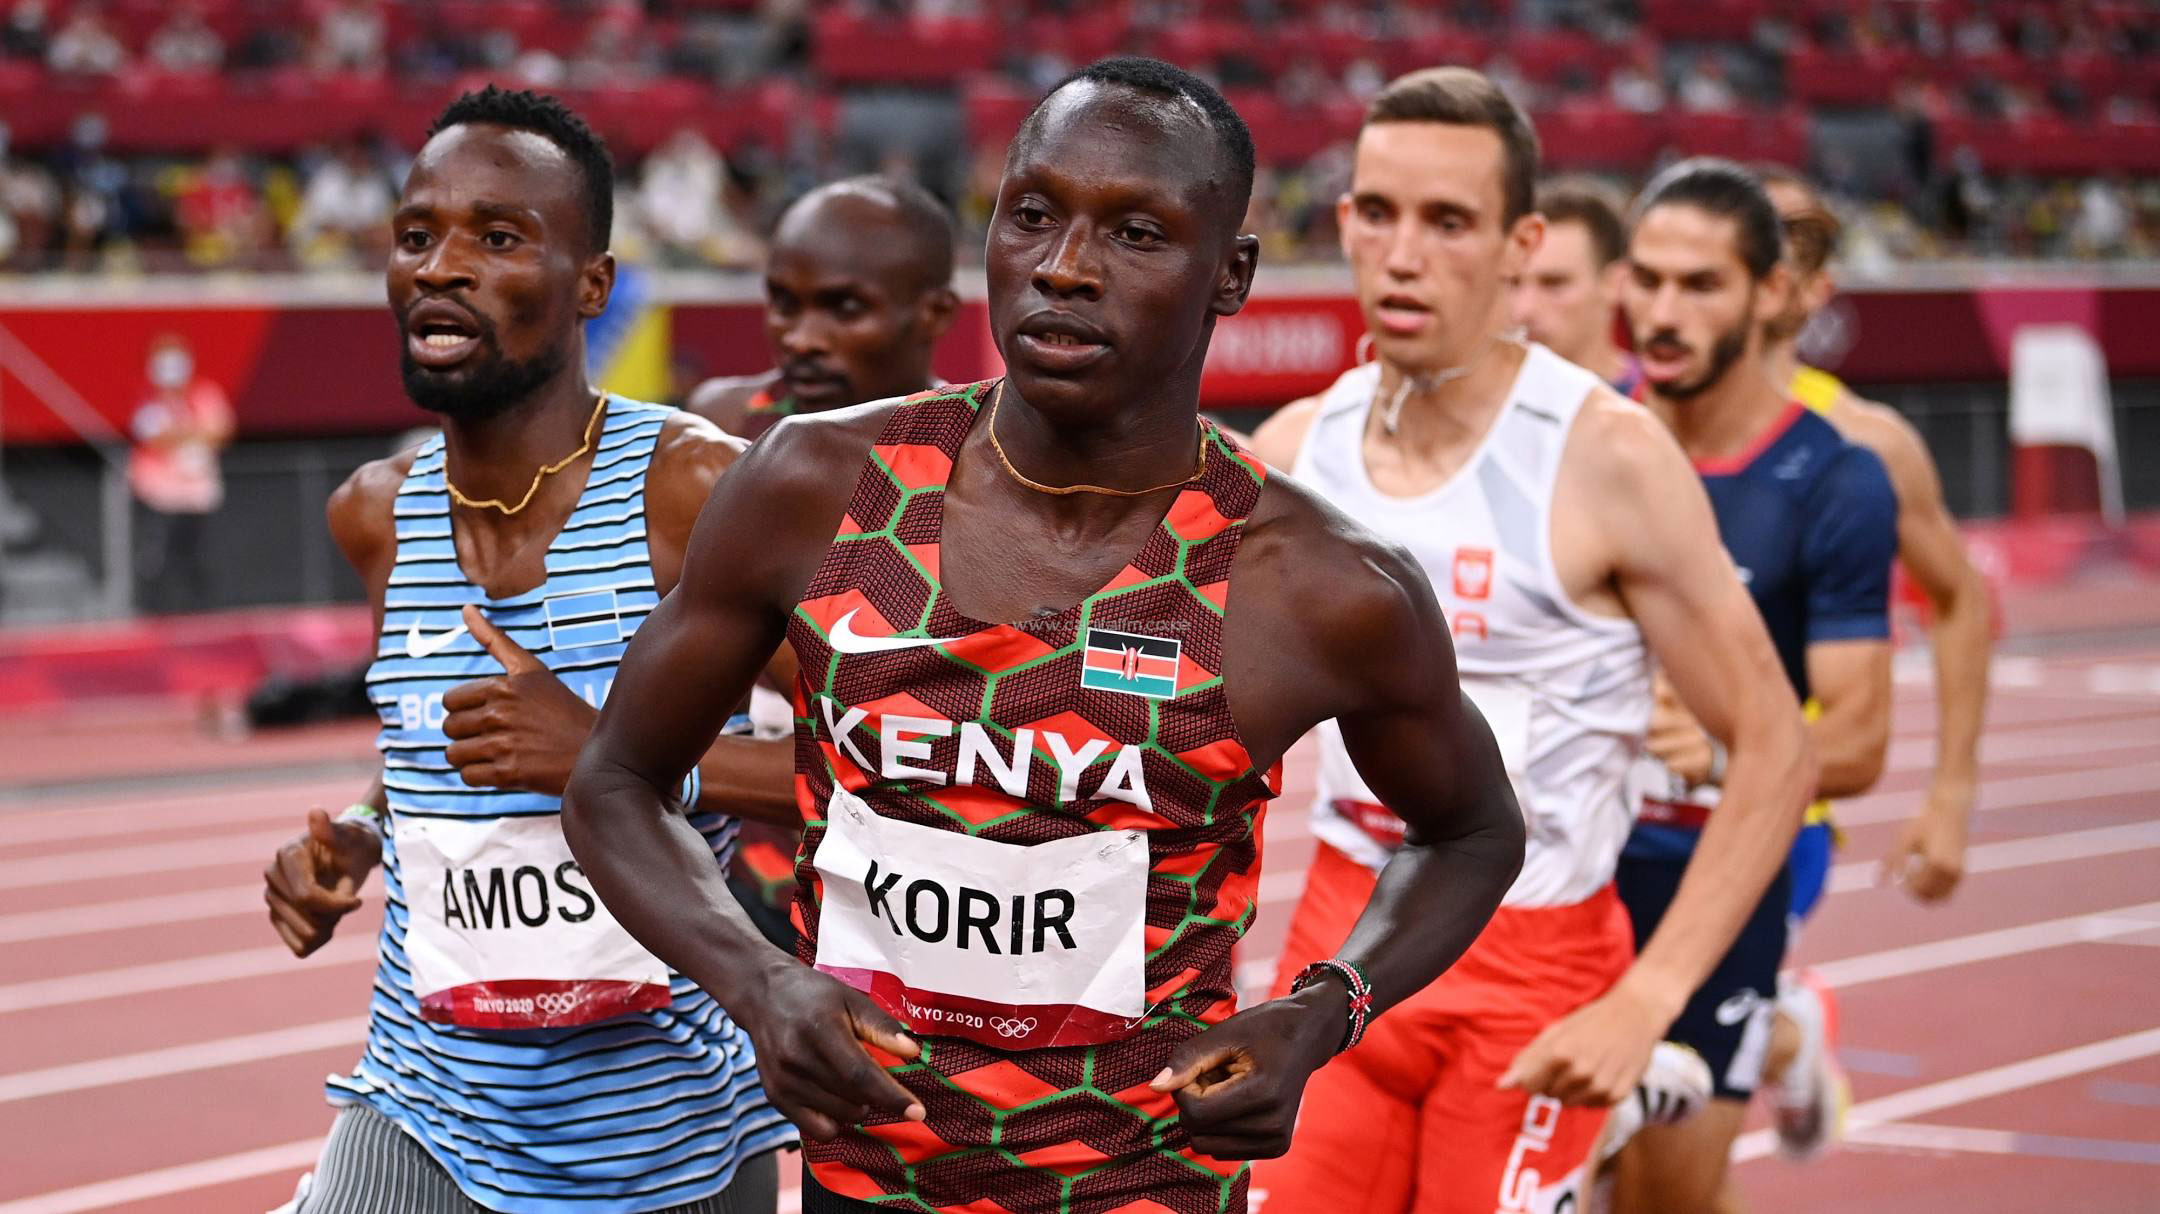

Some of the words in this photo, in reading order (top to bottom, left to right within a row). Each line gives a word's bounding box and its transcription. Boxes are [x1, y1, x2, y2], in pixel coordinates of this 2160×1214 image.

[821, 695, 1154, 813] KENYA
[443, 860, 596, 930] AMOS
[864, 860, 1077, 955] KORIR
[505, 998, 535, 1014] 2020
[946, 1012, 983, 1028] 2020
